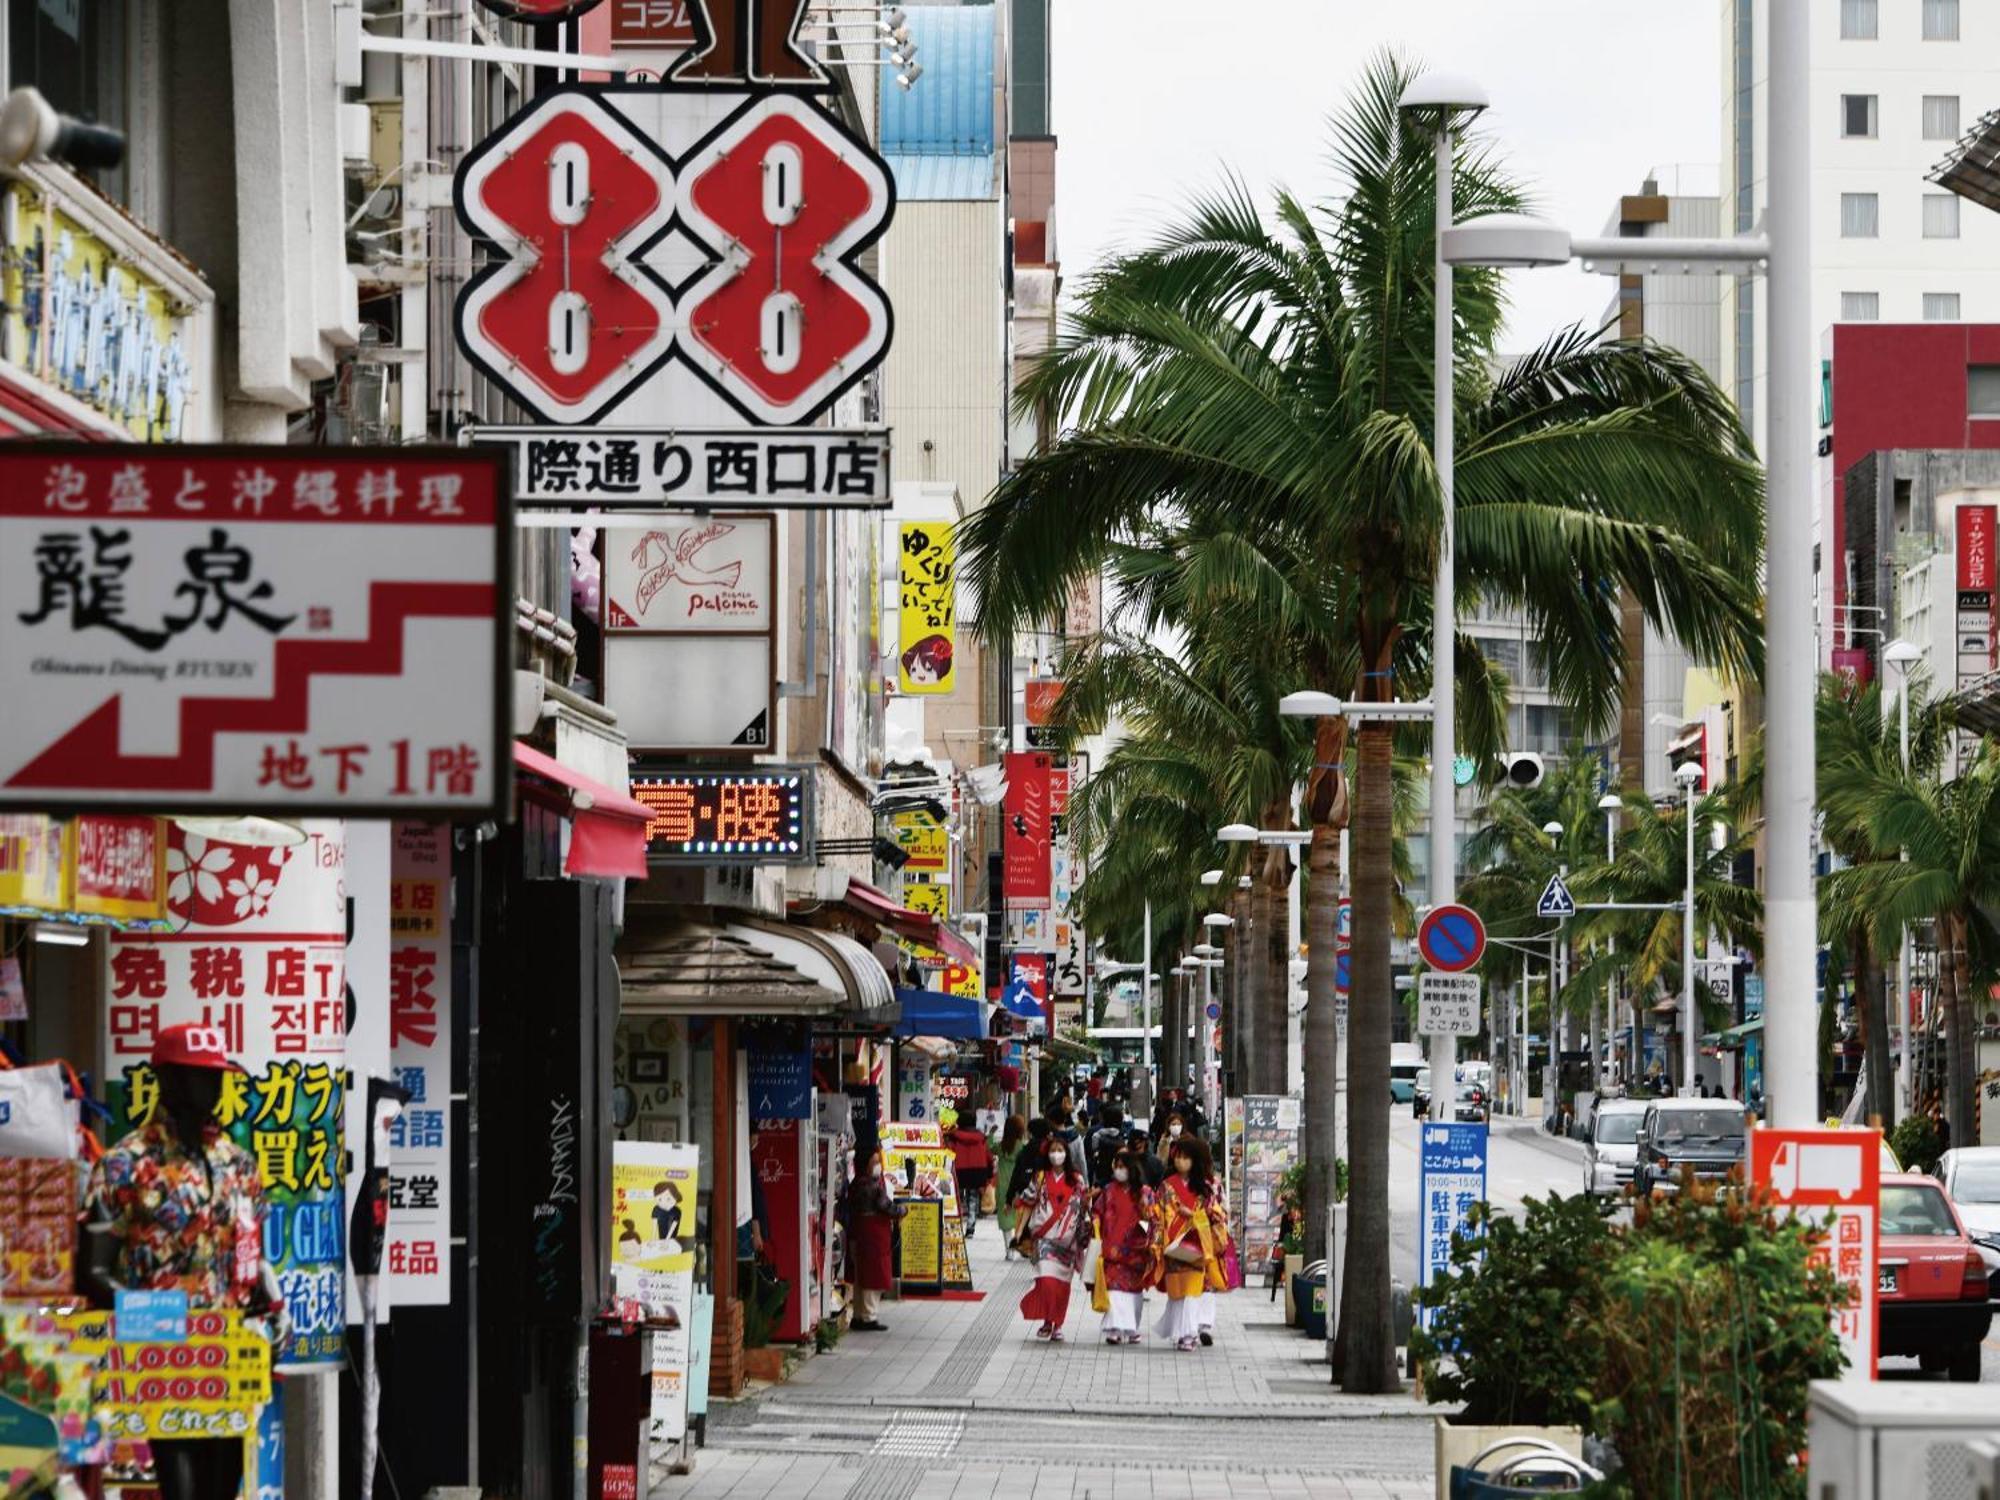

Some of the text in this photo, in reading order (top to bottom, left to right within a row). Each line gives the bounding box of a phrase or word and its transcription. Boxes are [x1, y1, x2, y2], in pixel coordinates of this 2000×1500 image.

[44, 464, 465, 516] 泡盛と沖縄料理
[473, 440, 878, 495] 際通り西口店
[18, 527, 297, 652] 龍泉
[611, 612, 626, 629] 1F
[258, 739, 481, 798] 地下1階
[111, 947, 305, 998] 免税店
